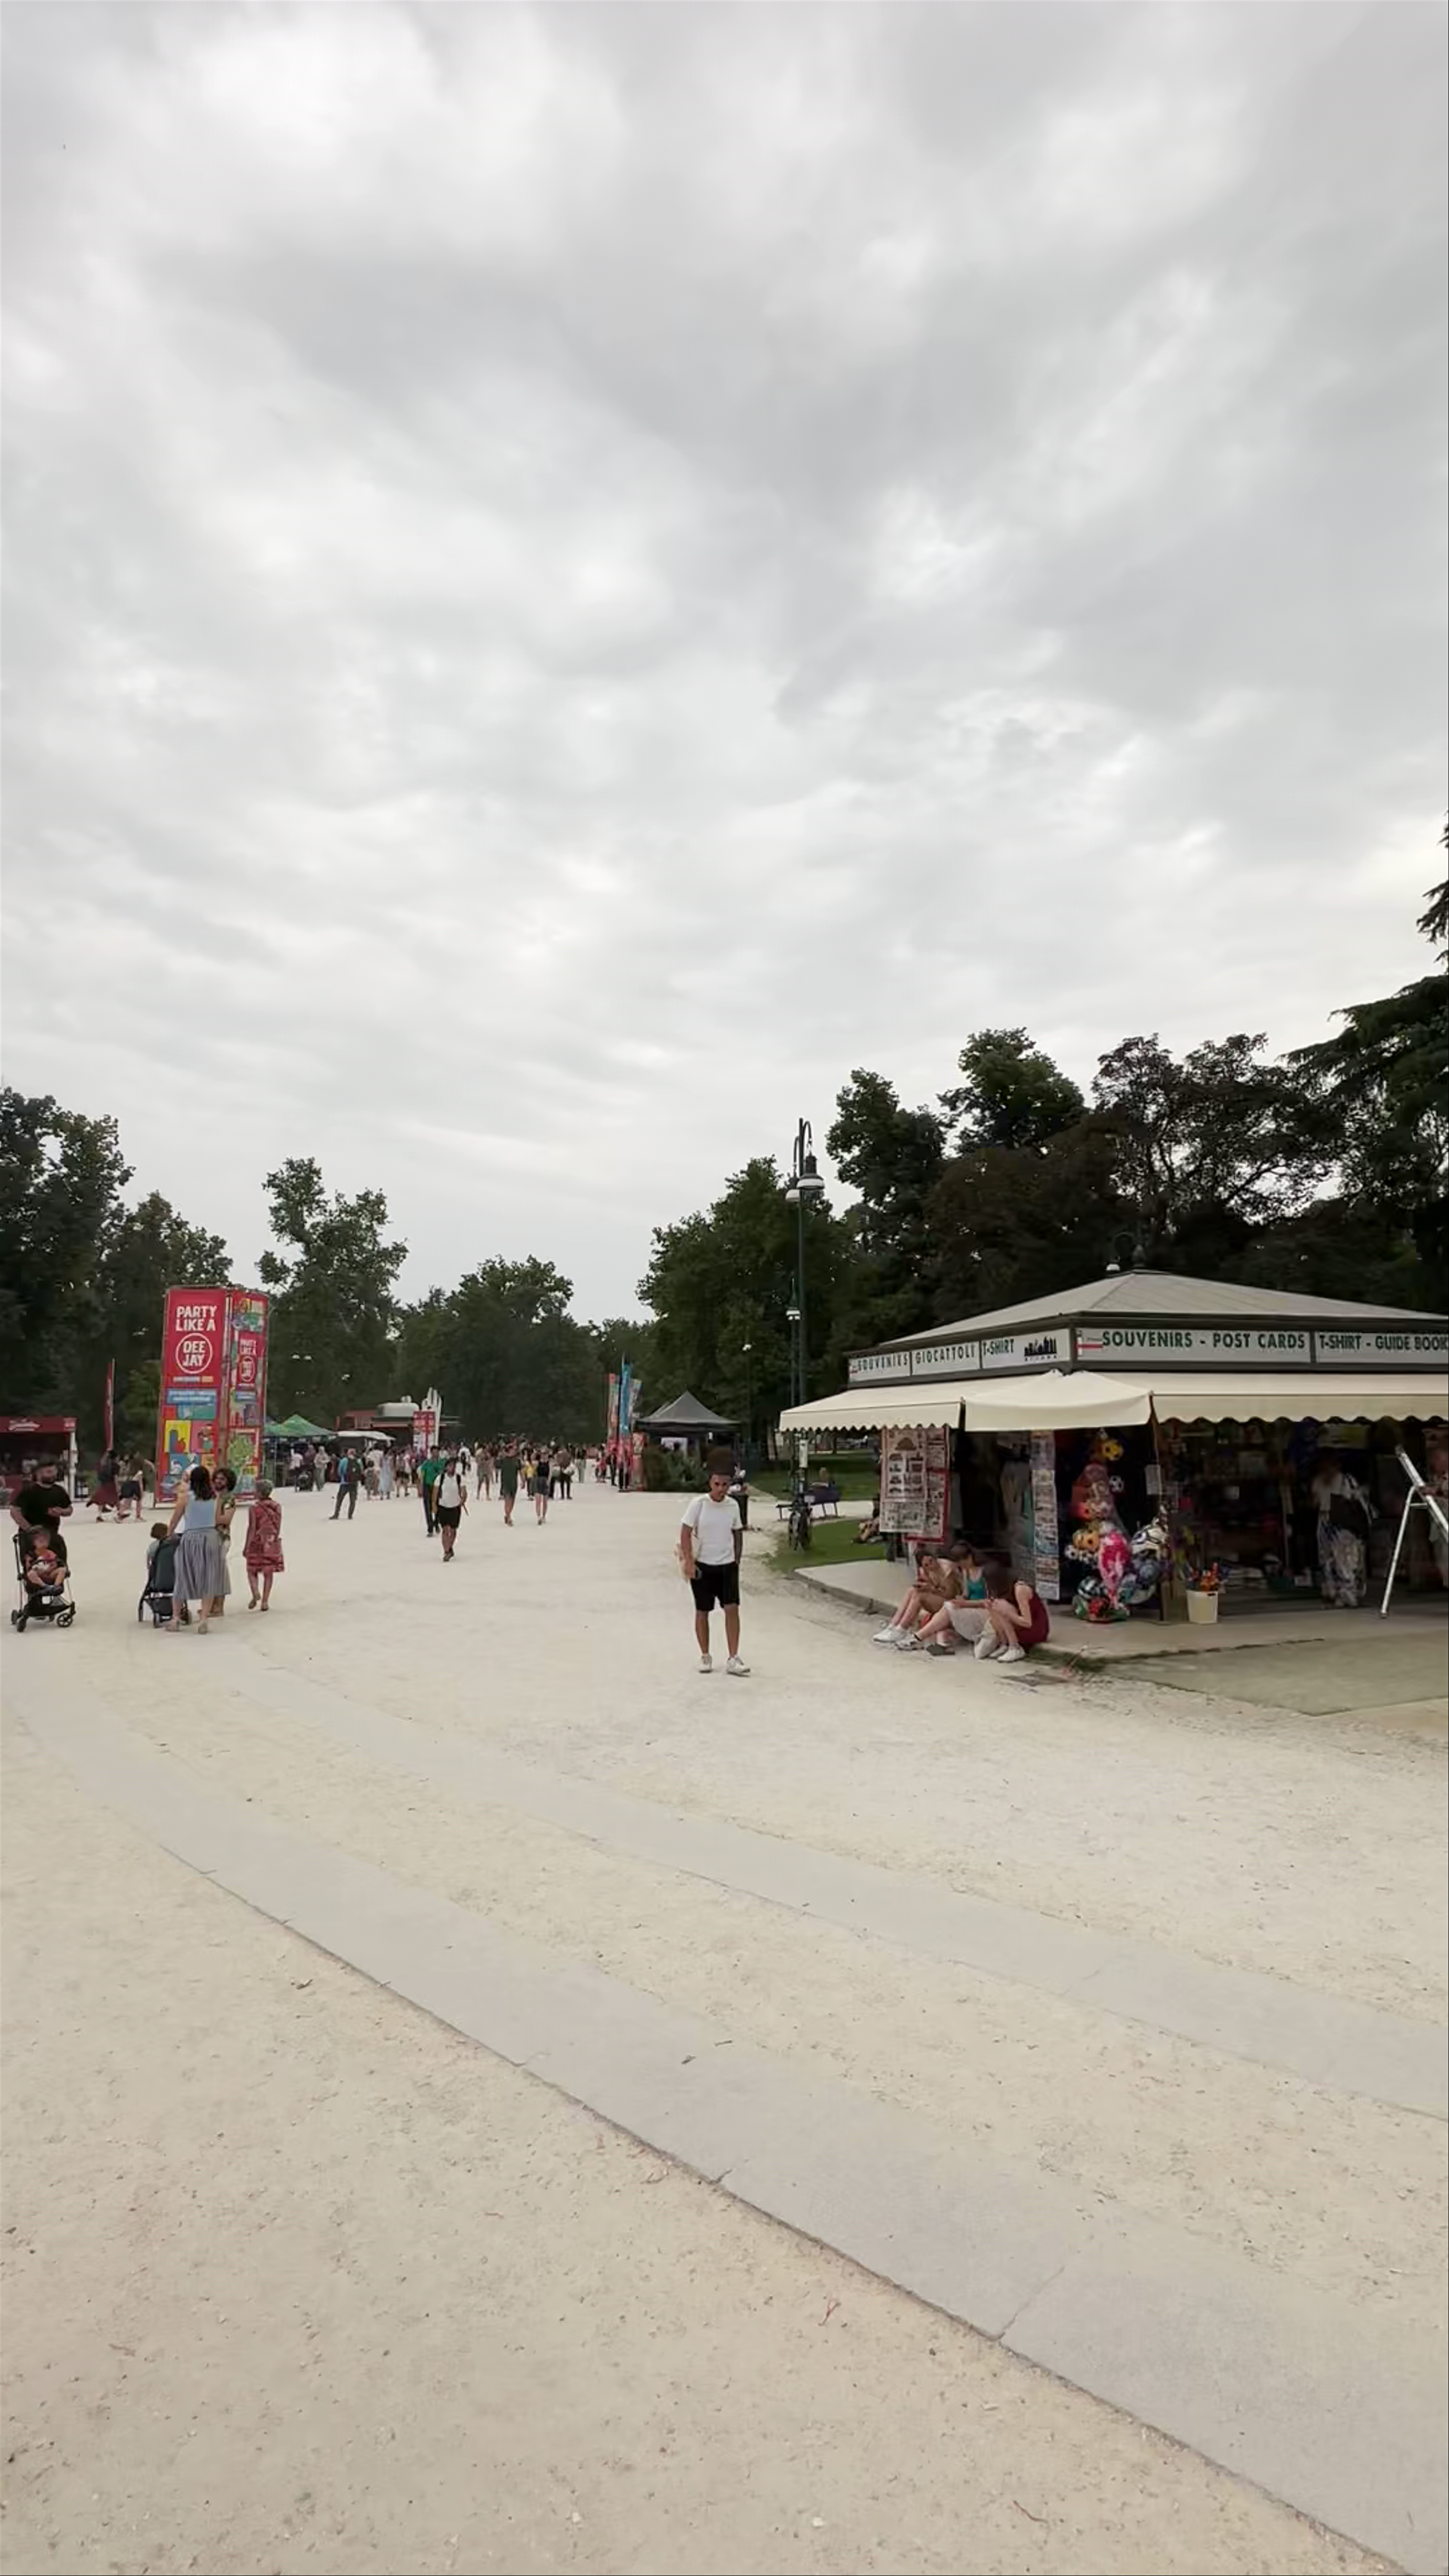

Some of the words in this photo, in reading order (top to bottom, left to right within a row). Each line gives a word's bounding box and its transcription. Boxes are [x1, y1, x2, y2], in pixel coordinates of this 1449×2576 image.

[176, 1306, 217, 1318] PARTY
[176, 1319, 205, 1331] LIKE
[206, 1319, 216, 1331] A
[983, 1338, 1014, 1356] T-SHIRT
[1103, 1331, 1192, 1347] SOUVENIRS
[1213, 1333, 1250, 1348] POST
[1258, 1333, 1305, 1349] CARDS
[1320, 1335, 1361, 1350] T-SHIRT
[1375, 1335, 1411, 1350] GUIDE
[183, 1341, 206, 1354] DEE
[916, 1344, 975, 1364] GIOCATTOLI
[182, 1354, 205, 1366] JAY
